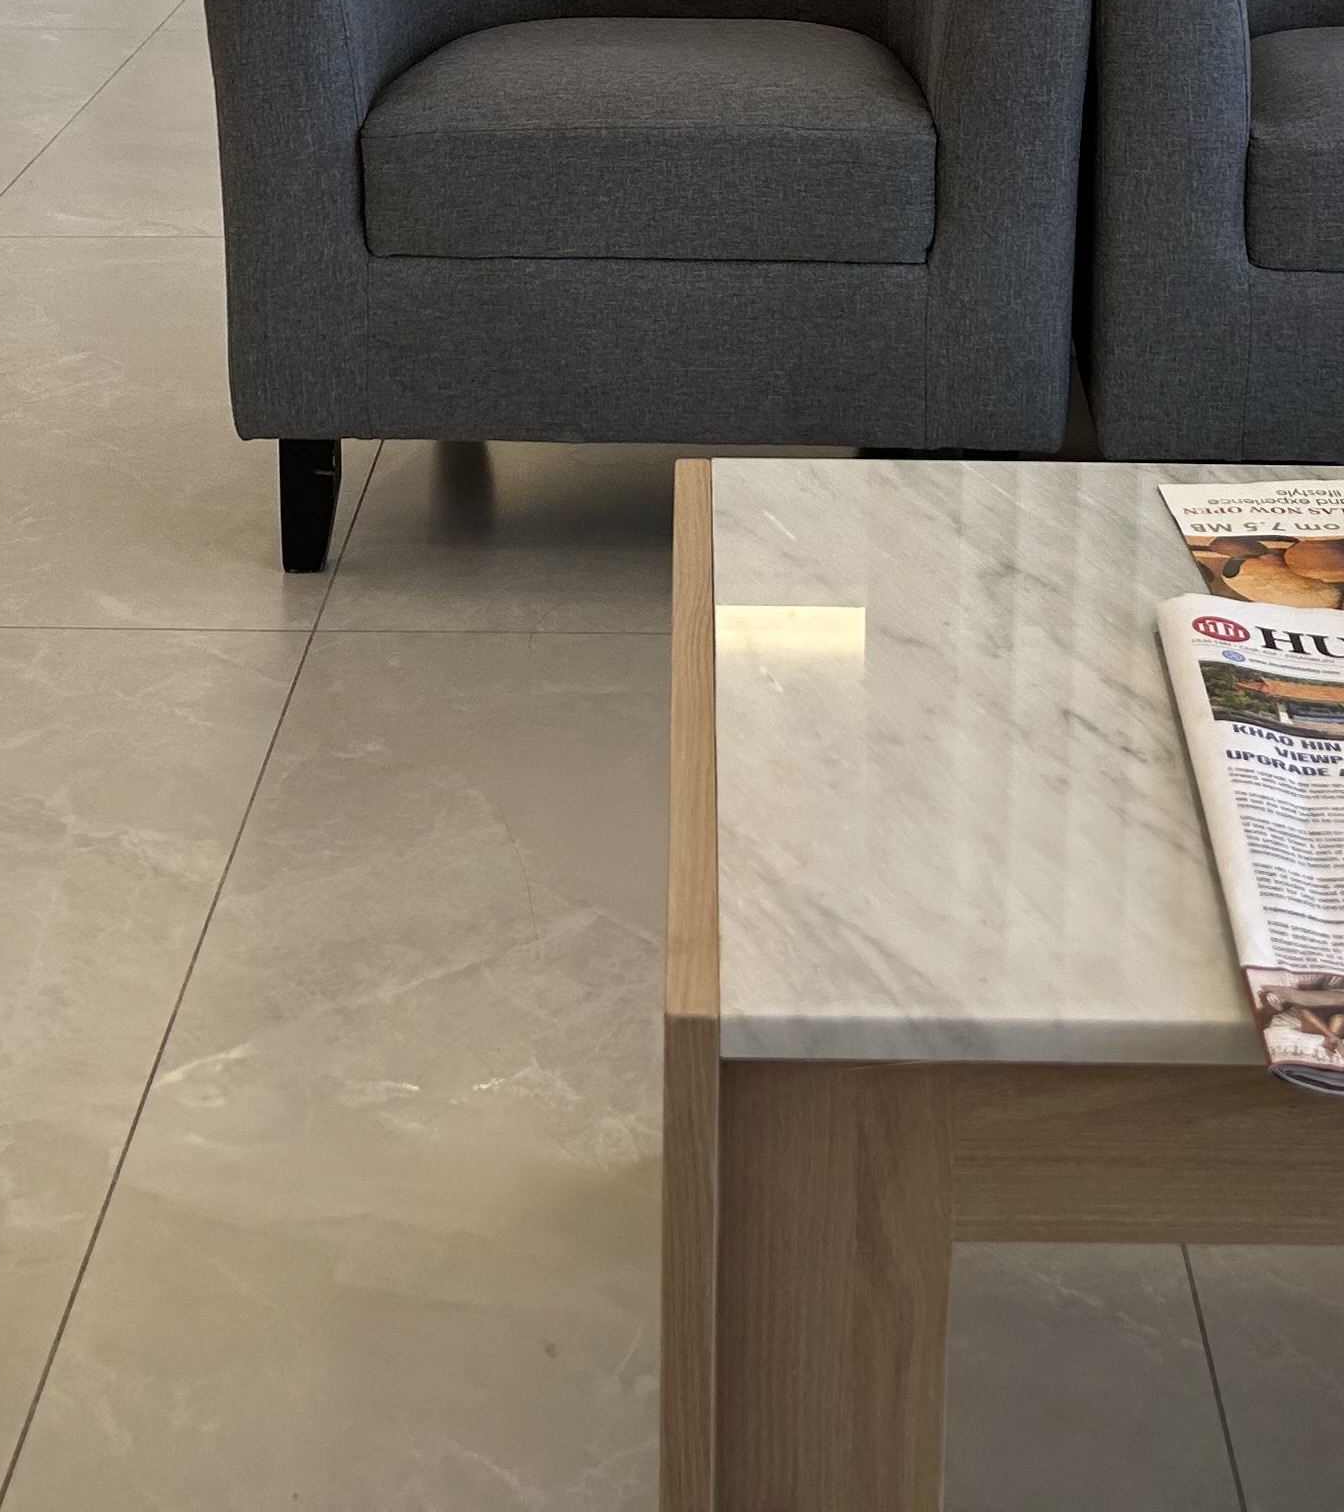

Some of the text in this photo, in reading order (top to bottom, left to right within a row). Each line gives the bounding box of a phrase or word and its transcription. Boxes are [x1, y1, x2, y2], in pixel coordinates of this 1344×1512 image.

[1232, 723, 1294, 747] KHAO
[1300, 739, 1342, 753] HIN
[1226, 749, 1331, 777] UPGRADE
